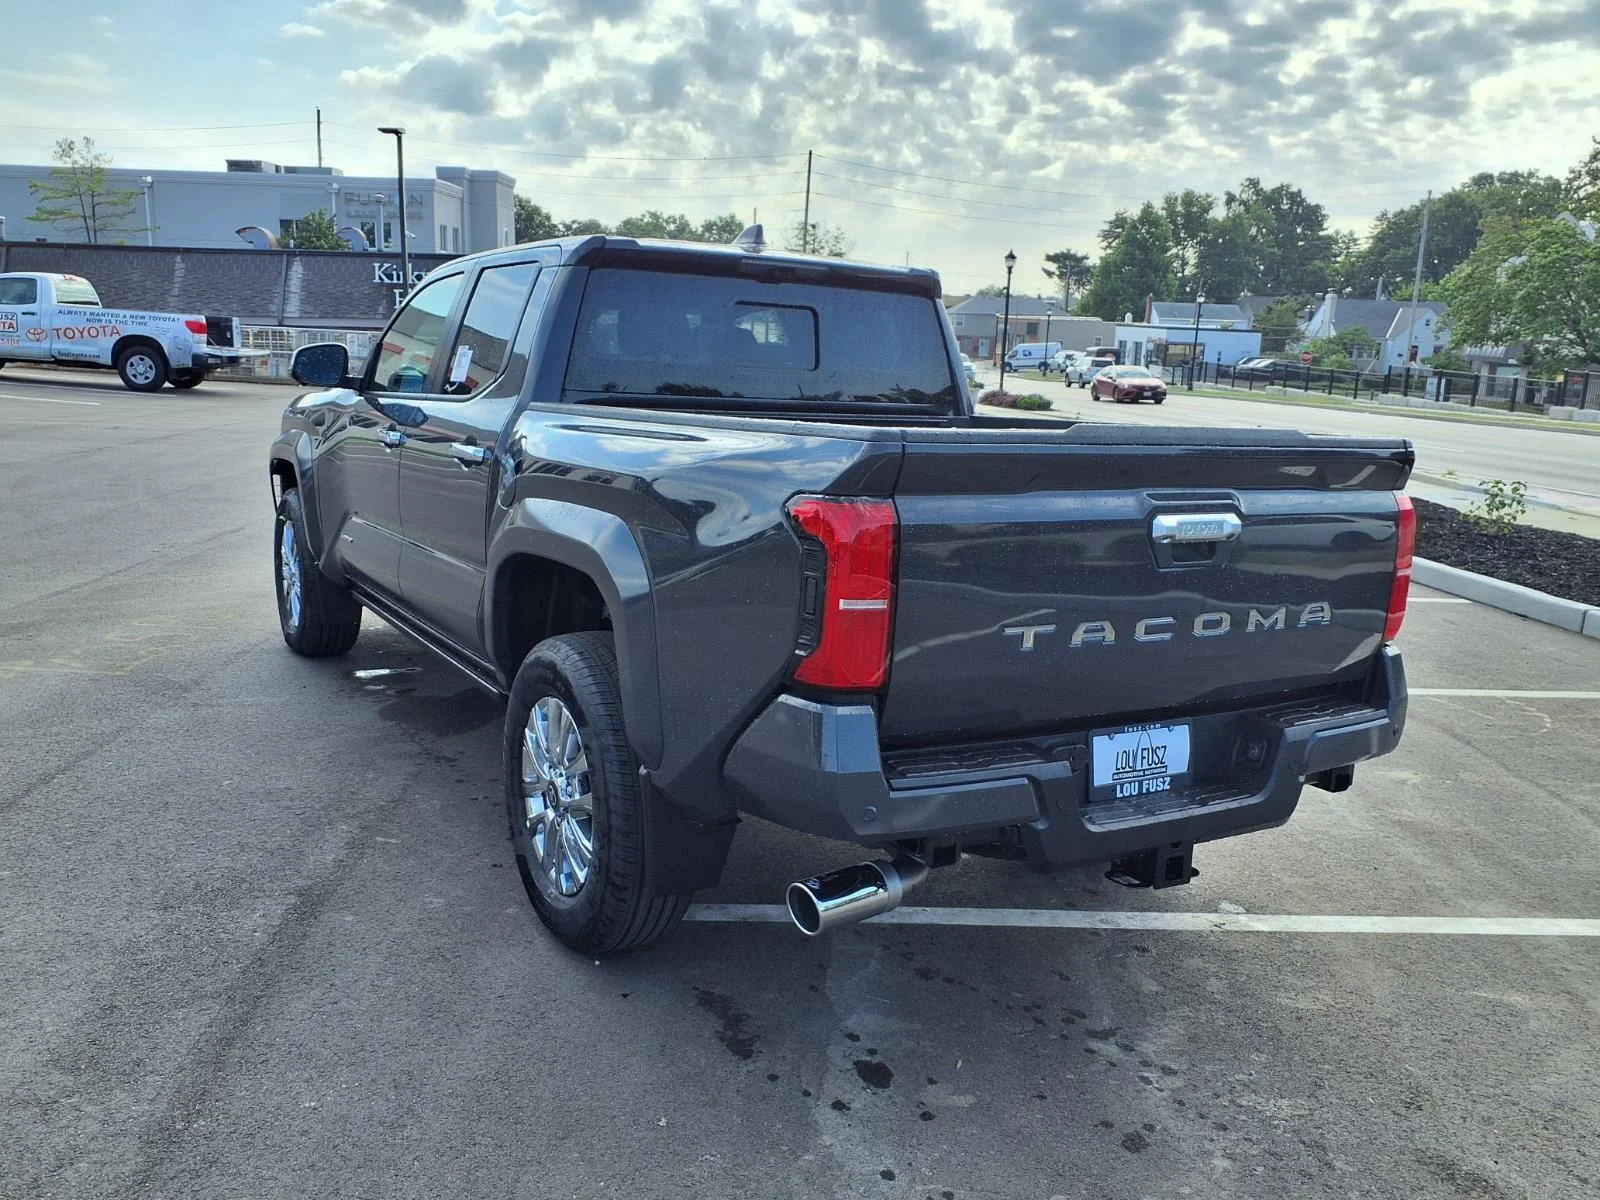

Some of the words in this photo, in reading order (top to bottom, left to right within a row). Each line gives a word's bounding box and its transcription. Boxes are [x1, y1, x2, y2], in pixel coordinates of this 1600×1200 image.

[89, 311, 120, 319] WANTED
[53, 324, 122, 340] TOYOTA
[1181, 522, 1219, 537] TOYOTA
[1002, 601, 1333, 651] TACOMA
[1115, 749, 1136, 771] LOU
[1140, 745, 1167, 768] FUSZ
[1113, 770, 1144, 780] AUTOMOTIVE
[1116, 782, 1138, 798] LOU
[1142, 777, 1171, 793] FUSZ
